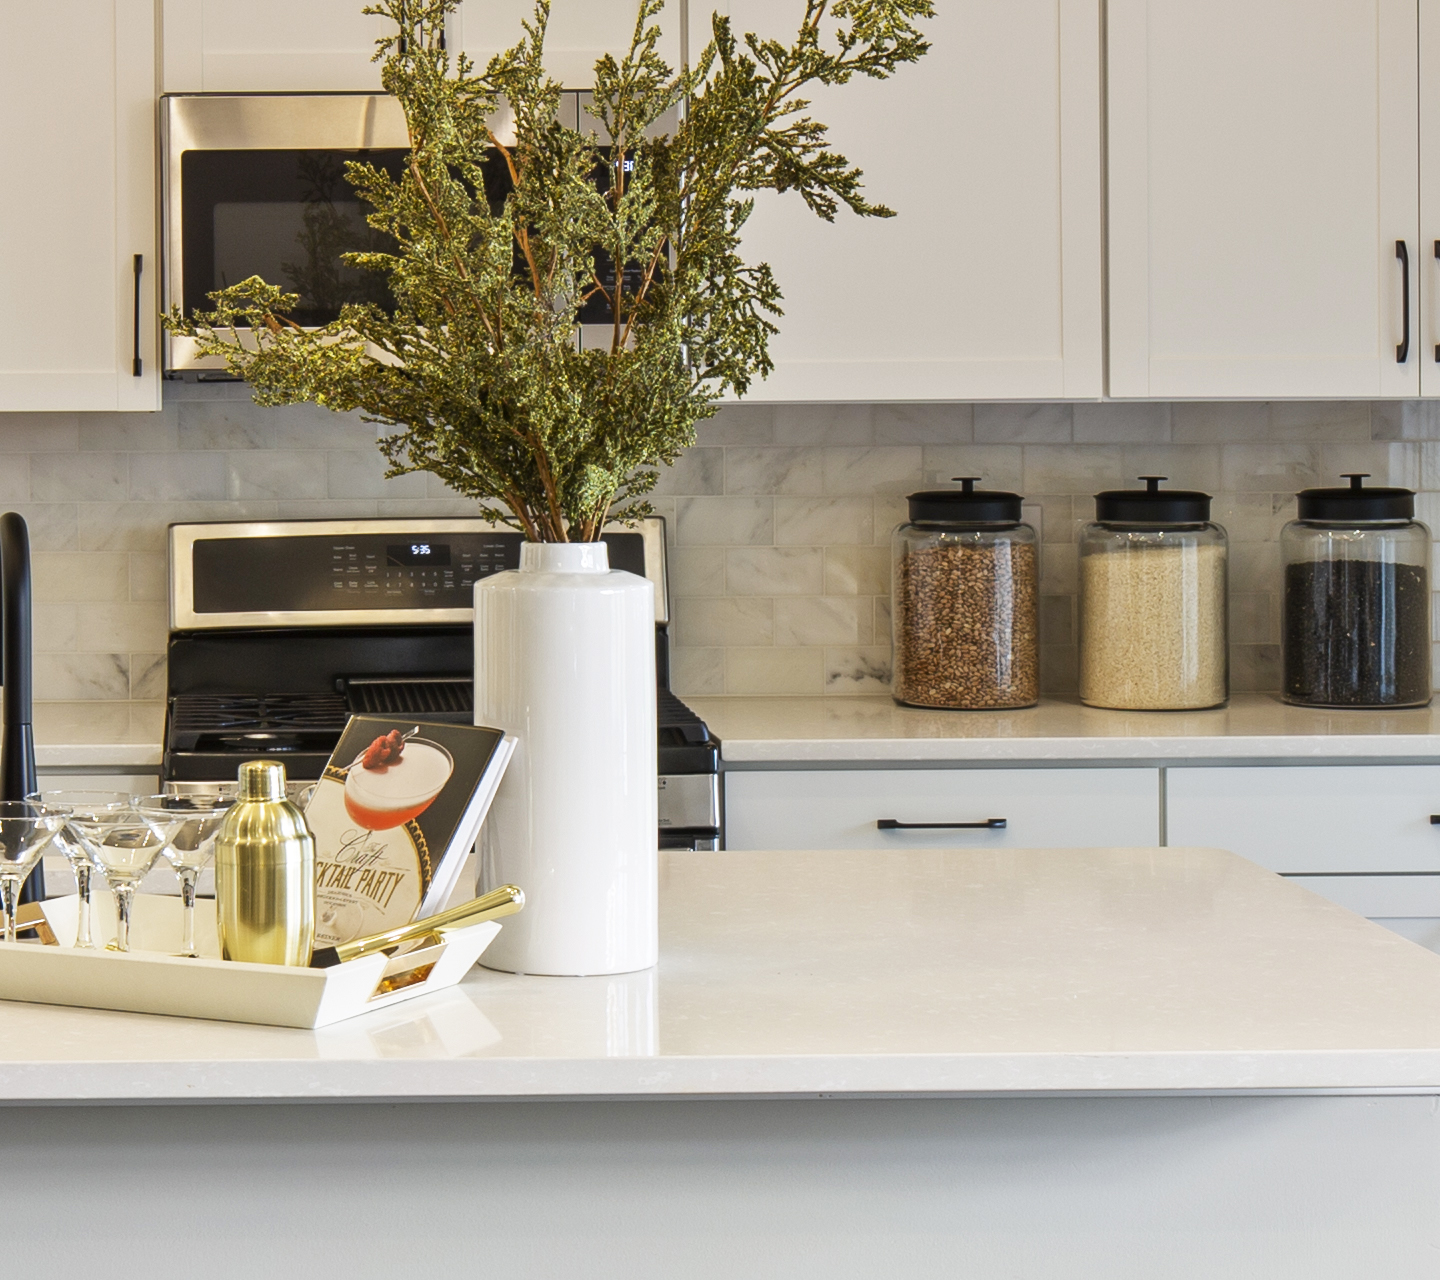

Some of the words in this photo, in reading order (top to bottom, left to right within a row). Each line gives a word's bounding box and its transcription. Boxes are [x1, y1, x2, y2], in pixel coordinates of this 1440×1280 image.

[411, 545, 431, 555] 5:35
[335, 829, 389, 874] Craft
[354, 867, 405, 909] PARTY
